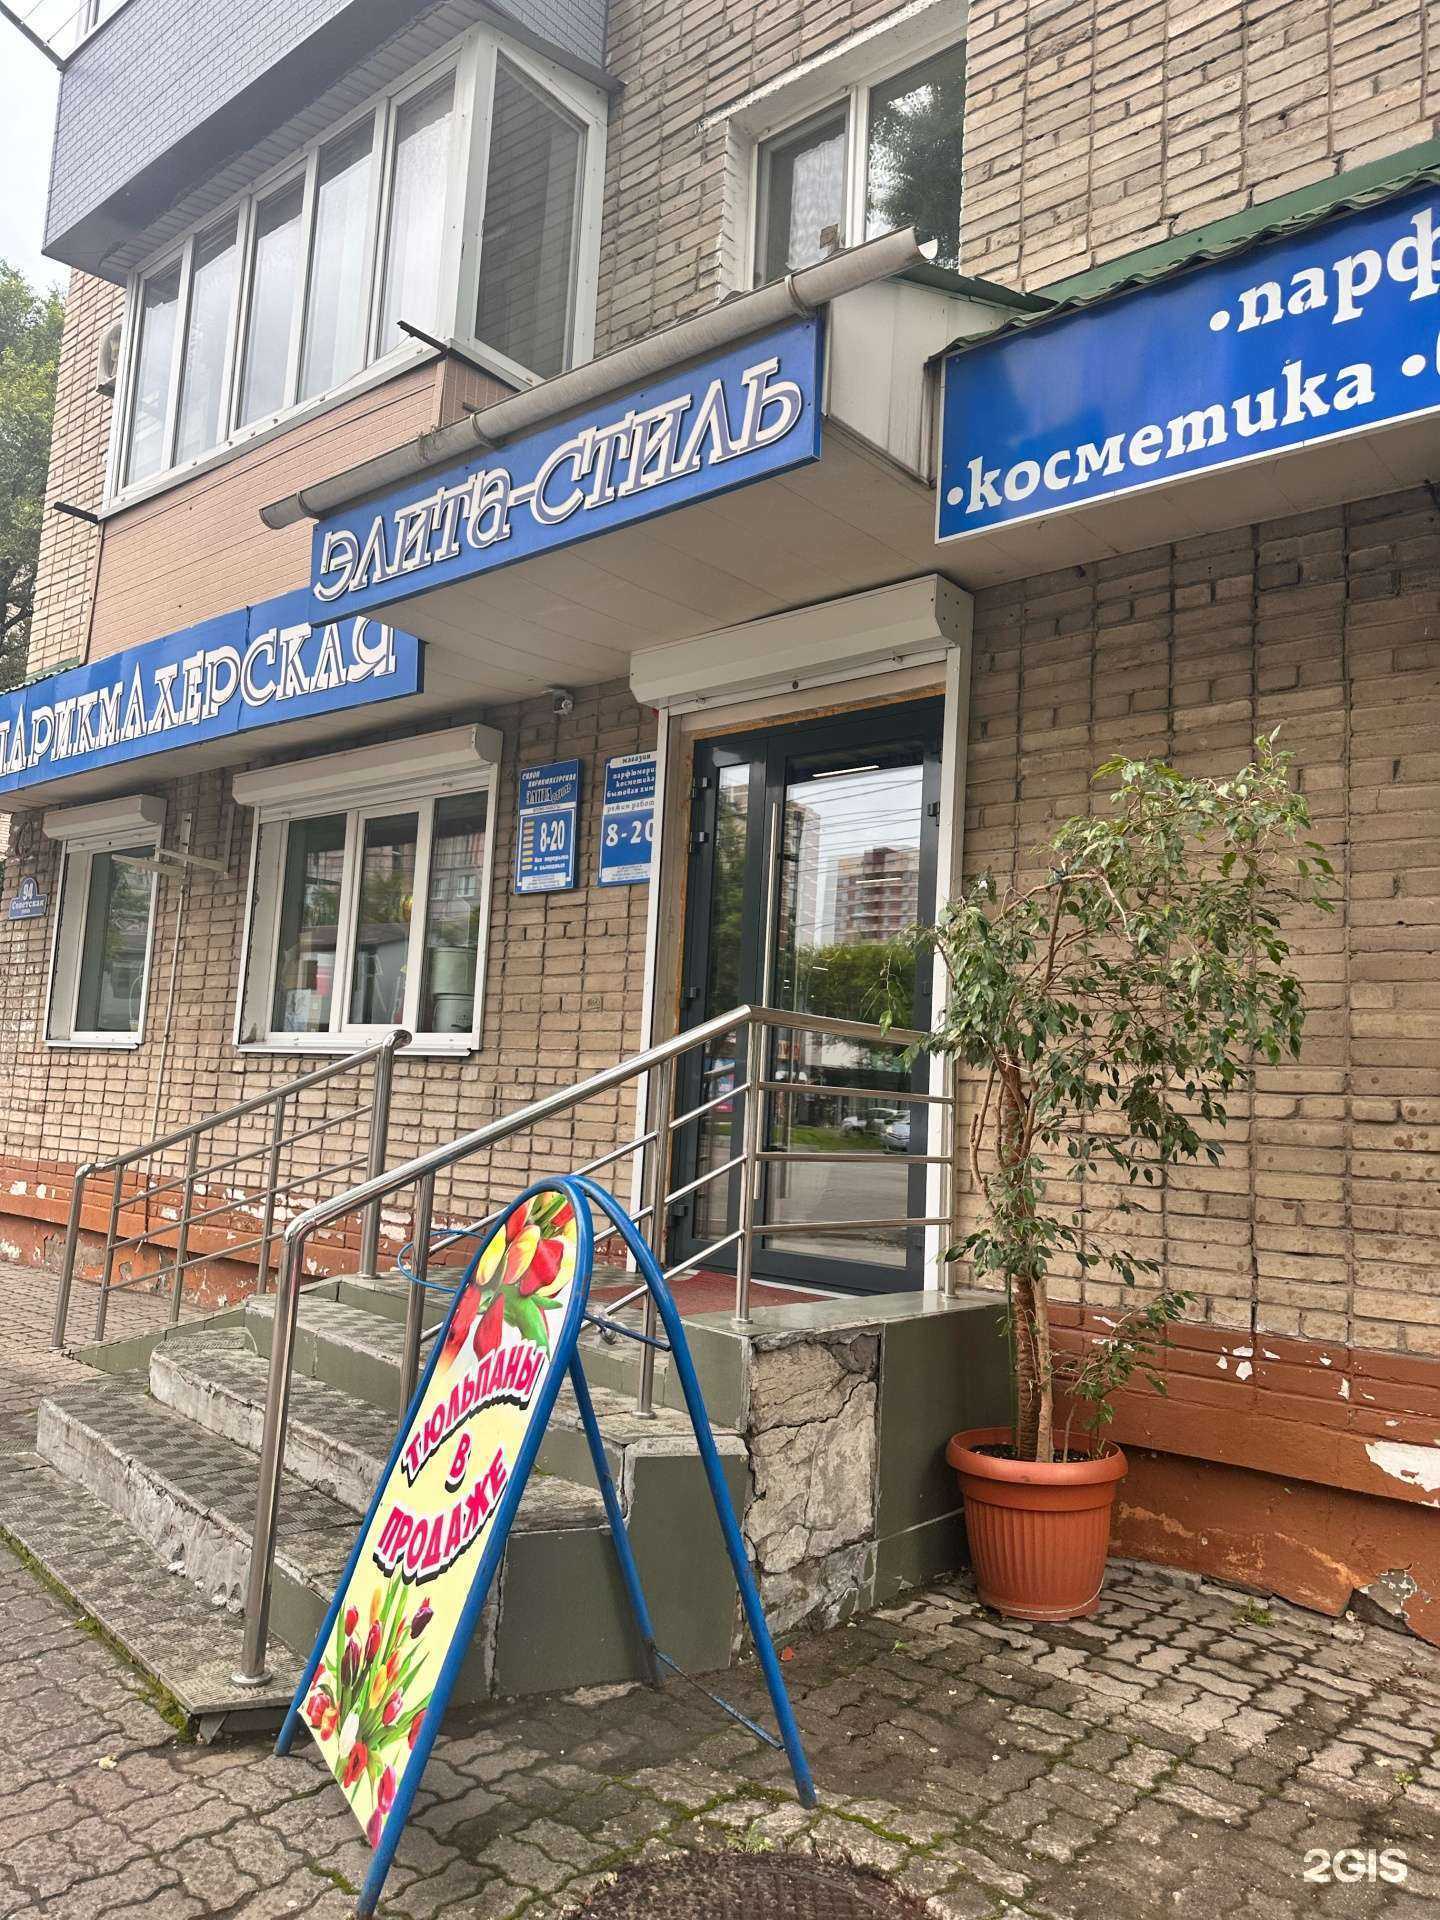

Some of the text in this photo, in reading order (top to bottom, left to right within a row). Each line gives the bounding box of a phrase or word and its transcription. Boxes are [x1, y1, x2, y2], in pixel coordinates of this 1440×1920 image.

[314, 356, 803, 601] ЭЛИТА-СТИЛЬ
[612, 768, 656, 780] парфюмери
[540, 819, 565, 852] 8-20
[403, 1343, 546, 1480] ТЮЛЬПАНЫ
[446, 1431, 472, 1484] В
[376, 1447, 508, 1574] ПРОДАЖЕ
